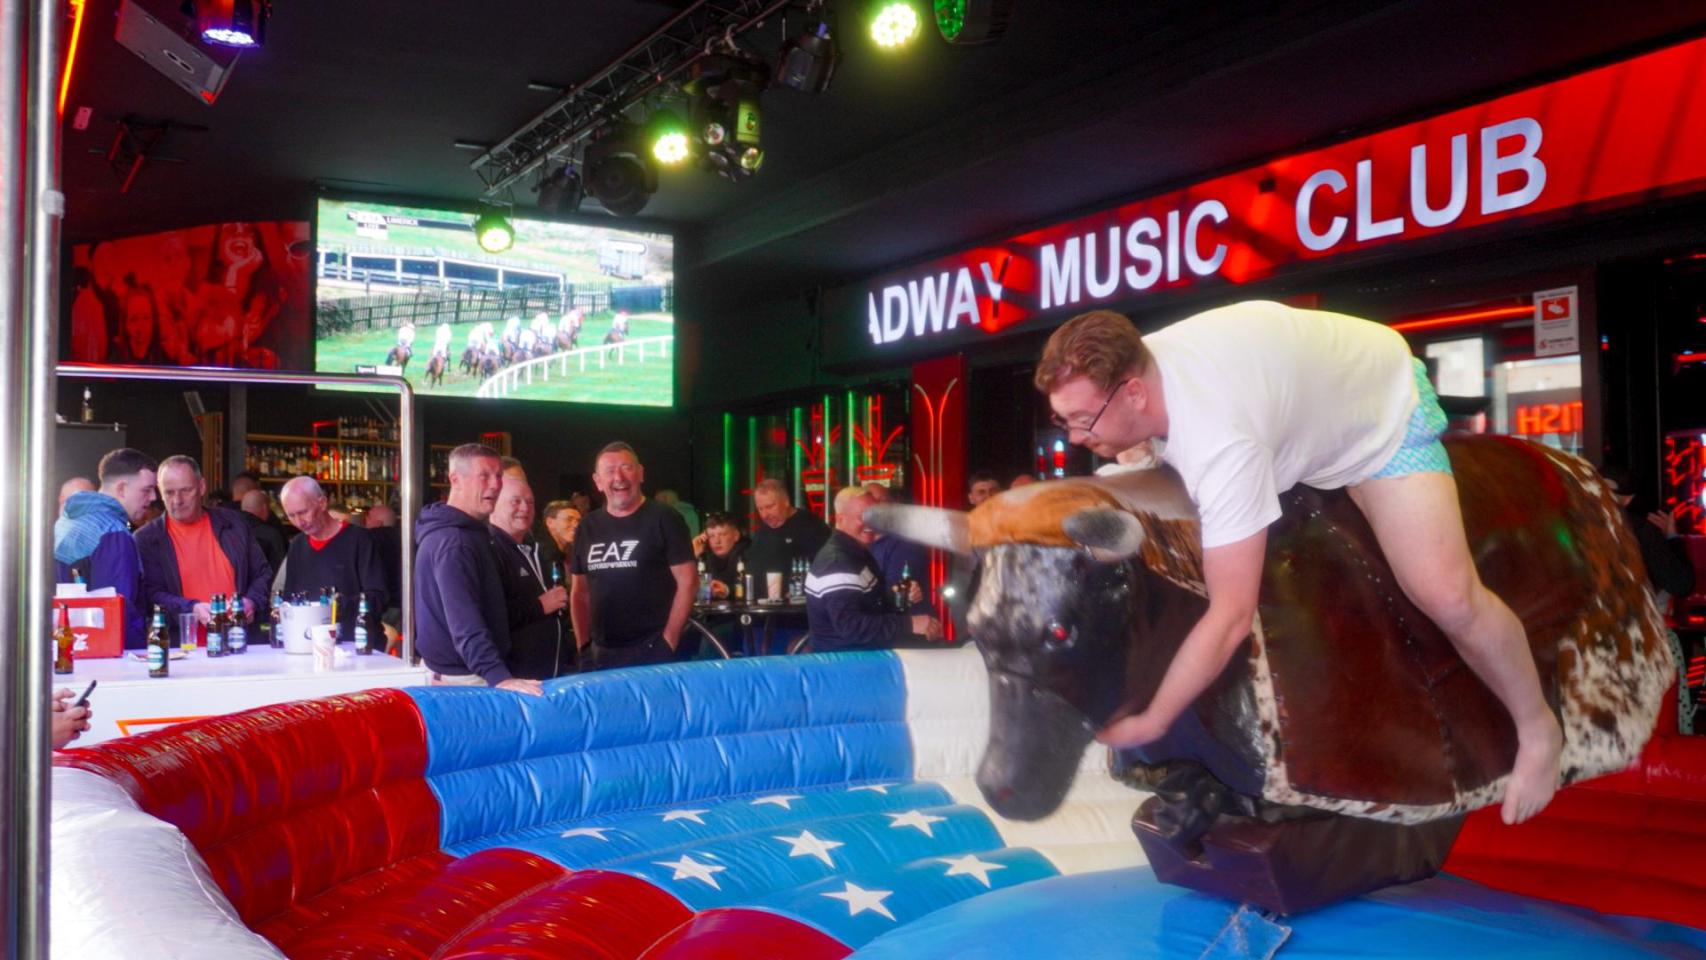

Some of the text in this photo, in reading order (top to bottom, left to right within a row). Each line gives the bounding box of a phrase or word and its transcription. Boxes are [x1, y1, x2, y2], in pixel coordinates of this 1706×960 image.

[1040, 199, 1229, 310] MUSIC
[1295, 116, 1547, 251] CLUB
[587, 539, 639, 563] EA7
